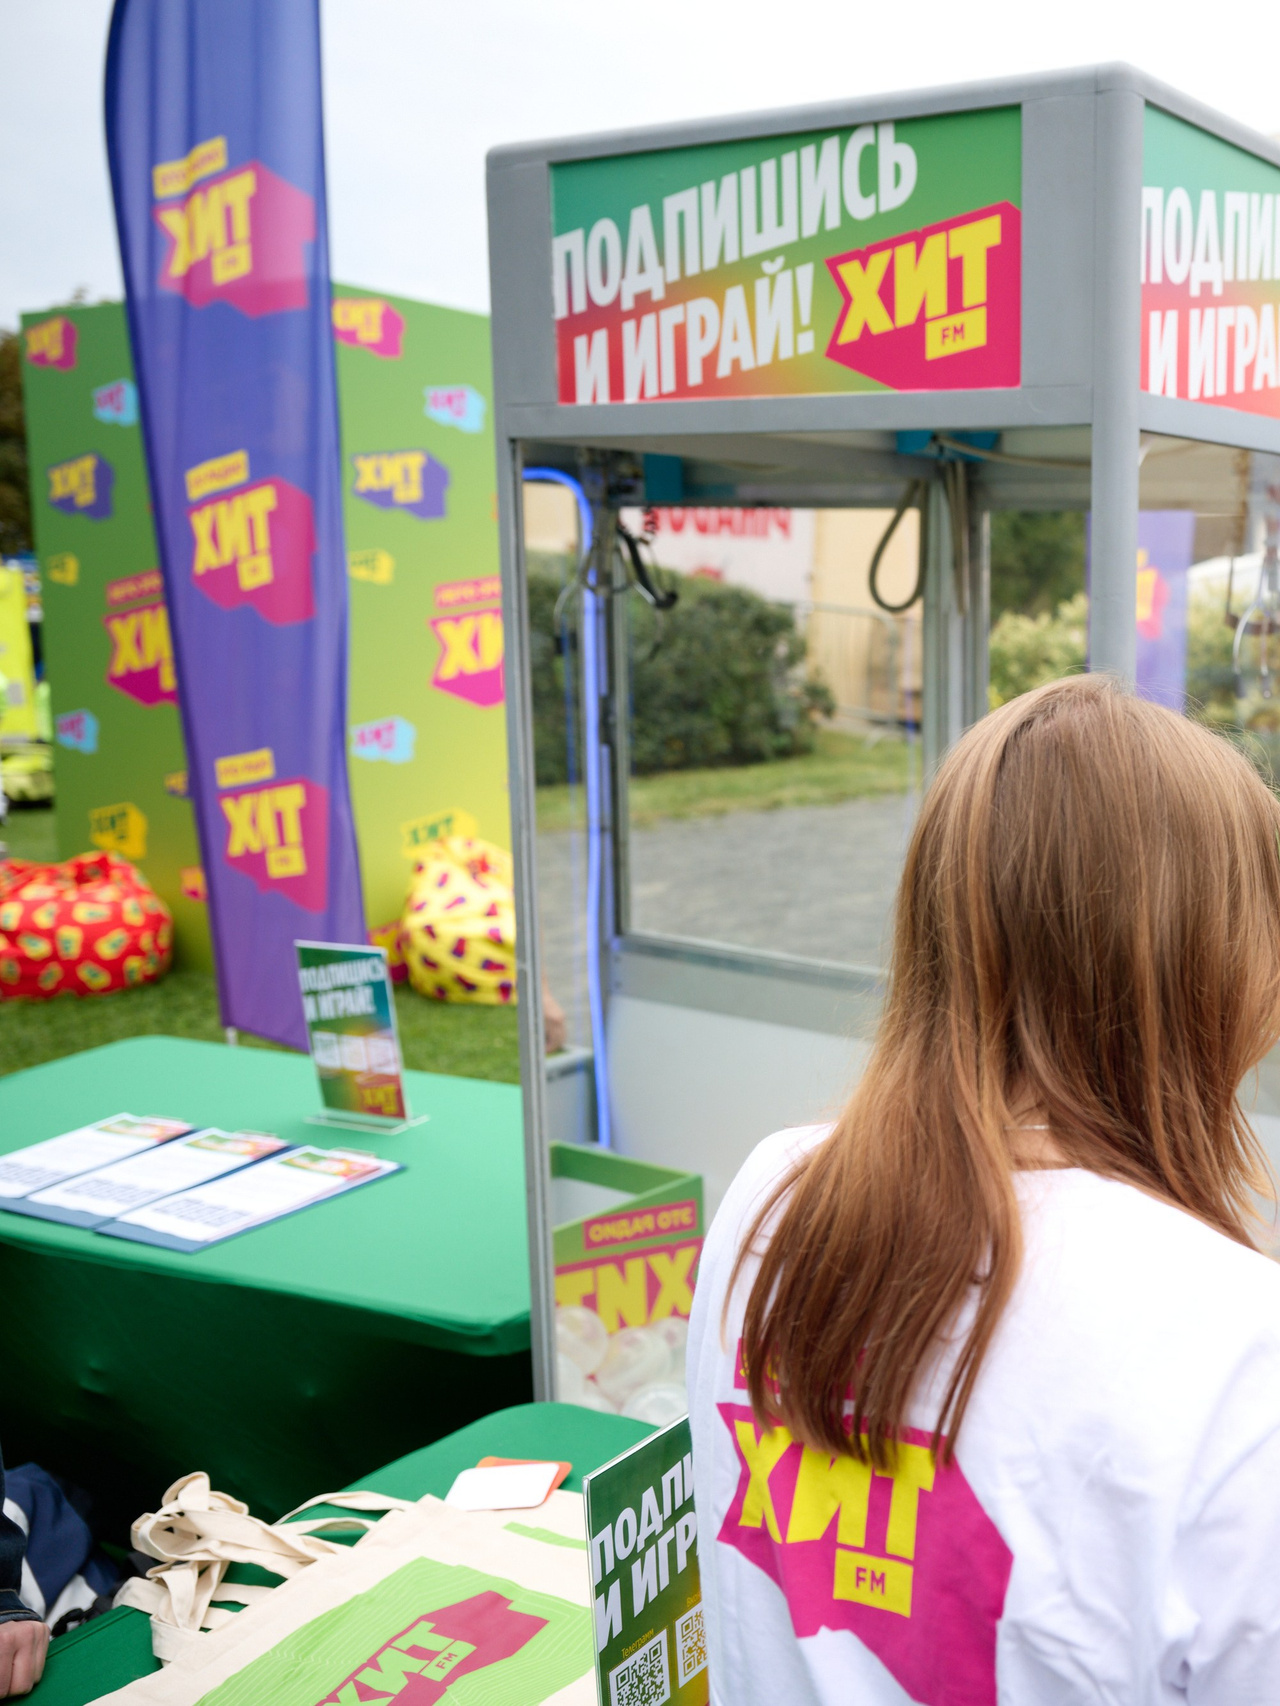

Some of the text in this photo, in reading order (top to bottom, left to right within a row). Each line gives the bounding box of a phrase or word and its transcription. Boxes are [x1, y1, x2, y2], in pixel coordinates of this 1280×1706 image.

[552, 121, 918, 320] ПОДПИШИСЬ
[836, 214, 1002, 346] ХИТ
[574, 256, 815, 406] И ИГРАЙ!
[941, 322, 966, 346] FM
[1148, 308, 1178, 398] И
[190, 485, 277, 576] ХИТ
[300, 957, 387, 992] ПОДПИШИСЬ
[733, 1419, 937, 1561] ХИТ
[594, 1511, 699, 1654] И ИГР
[855, 1566, 887, 1596] FM
[435, 1652, 458, 1670] FM
[621, 1627, 655, 1659] Телеграмм
